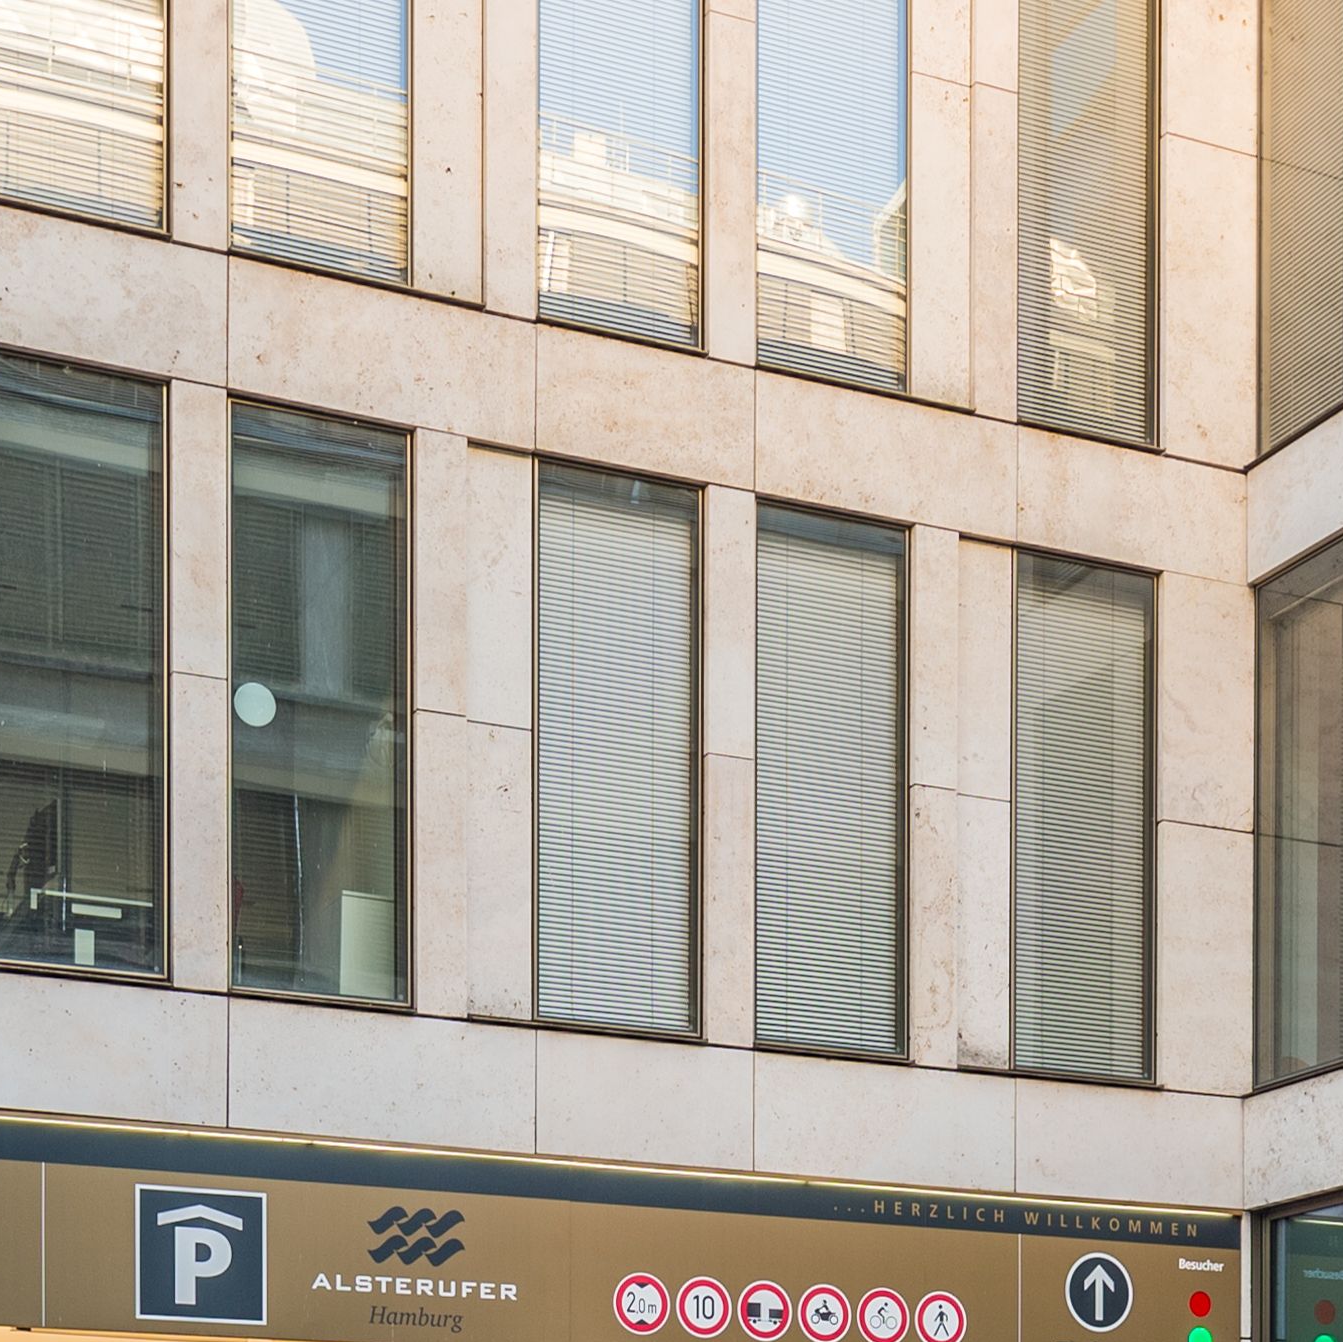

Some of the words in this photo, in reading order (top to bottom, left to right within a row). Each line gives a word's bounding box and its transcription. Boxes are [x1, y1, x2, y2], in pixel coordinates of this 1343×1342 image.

[1024, 1211, 1199, 1238] WILLKOMMEN
[174, 1225, 233, 1306] P
[1178, 1257, 1224, 1273] Besucher
[311, 1273, 518, 1302] ALSTERUFER
[369, 1305, 464, 1333] Hamburg
[693, 1295, 715, 1320] 10
